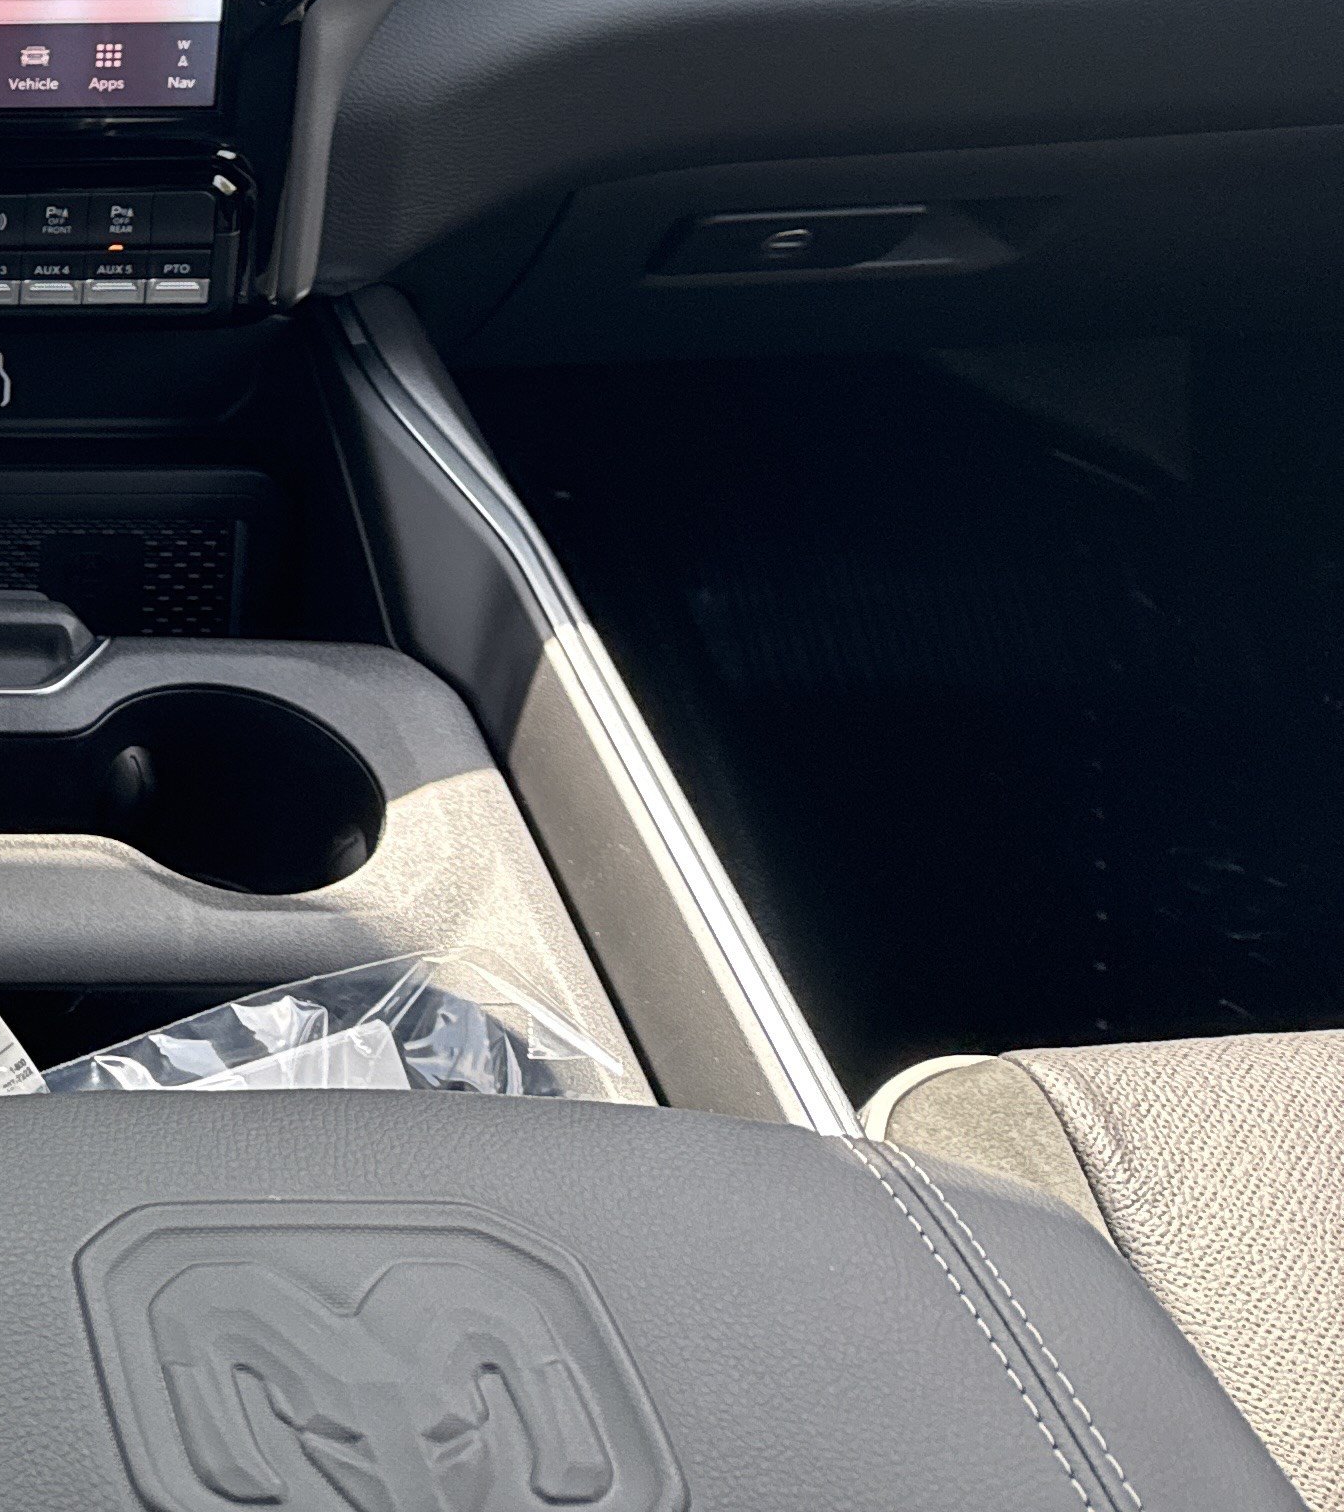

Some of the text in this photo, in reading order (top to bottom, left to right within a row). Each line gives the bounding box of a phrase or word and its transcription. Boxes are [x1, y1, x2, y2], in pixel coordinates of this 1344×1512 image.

[8, 77, 60, 91] Vehicle
[88, 77, 125, 92] Apps
[167, 76, 197, 90] Nav
[42, 224, 73, 235] FRONT
[108, 224, 134, 234] REAR
[0, 265, 7, 275] 3
[34, 265, 70, 276] AUX 4
[96, 264, 134, 275] AUX 5
[163, 263, 191, 274] PTO
